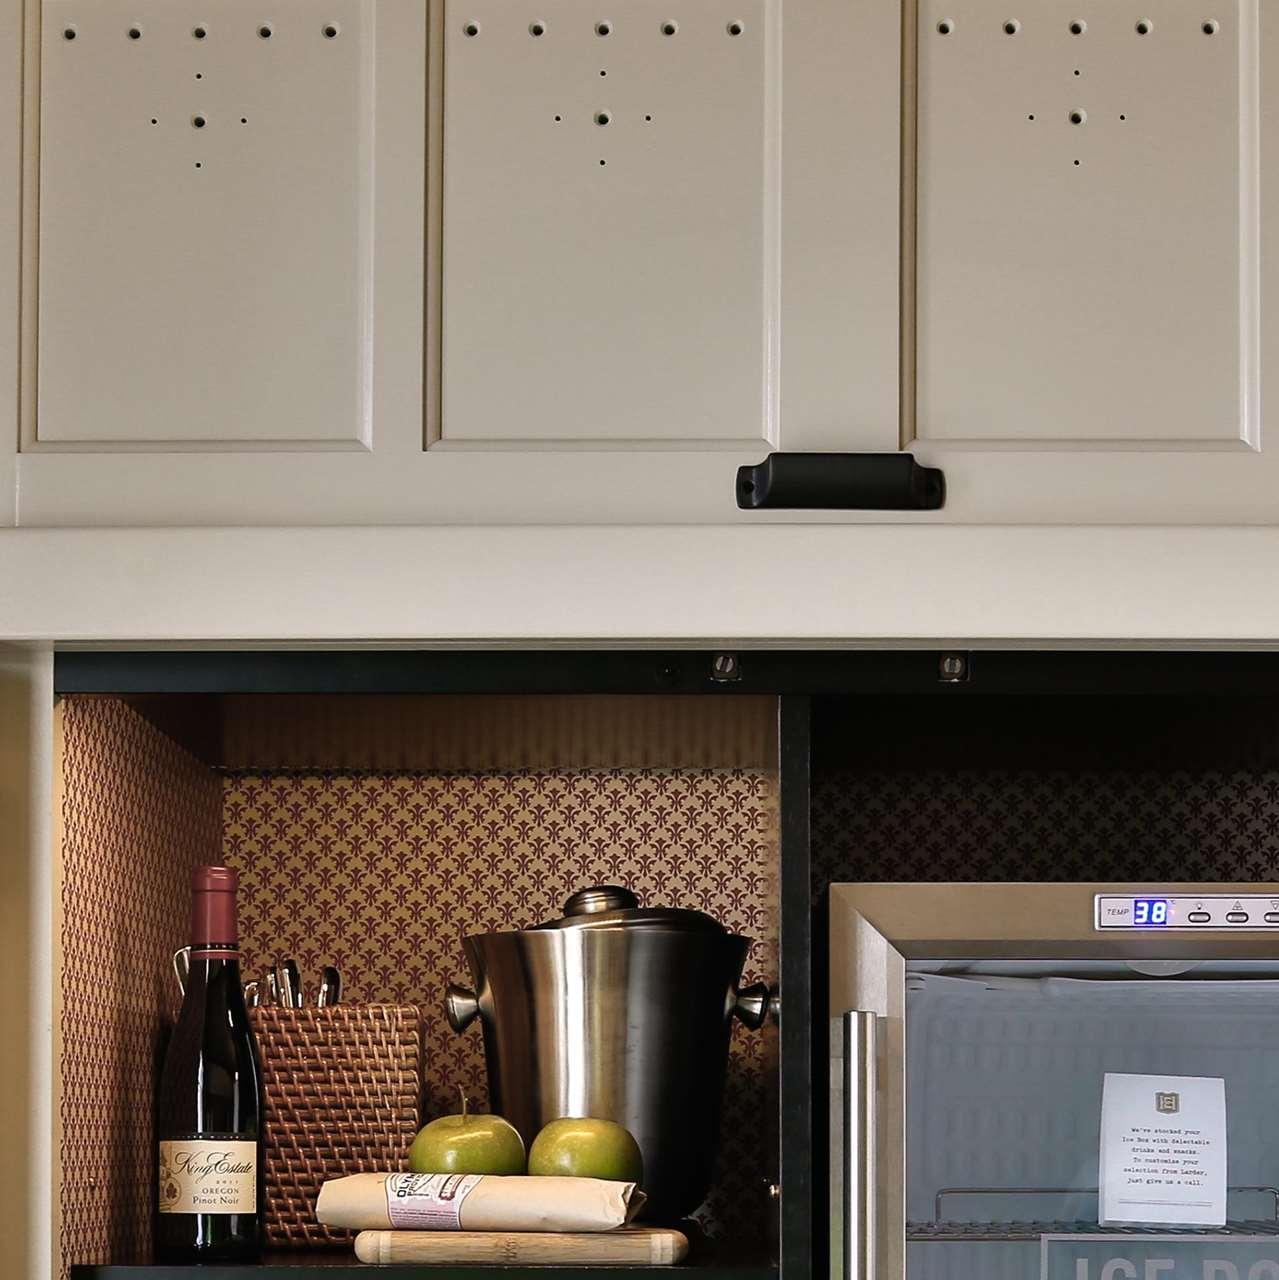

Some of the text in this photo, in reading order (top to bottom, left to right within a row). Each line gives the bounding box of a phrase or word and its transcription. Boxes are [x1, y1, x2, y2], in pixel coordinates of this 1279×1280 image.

[1106, 901, 1167, 924] TEMP 38
[1171, 1138, 1210, 1146] delectable
[174, 1152, 253, 1185] King Estate
[201, 1187, 239, 1195] OREGON
[192, 1195, 239, 1205] Pinot Noir
